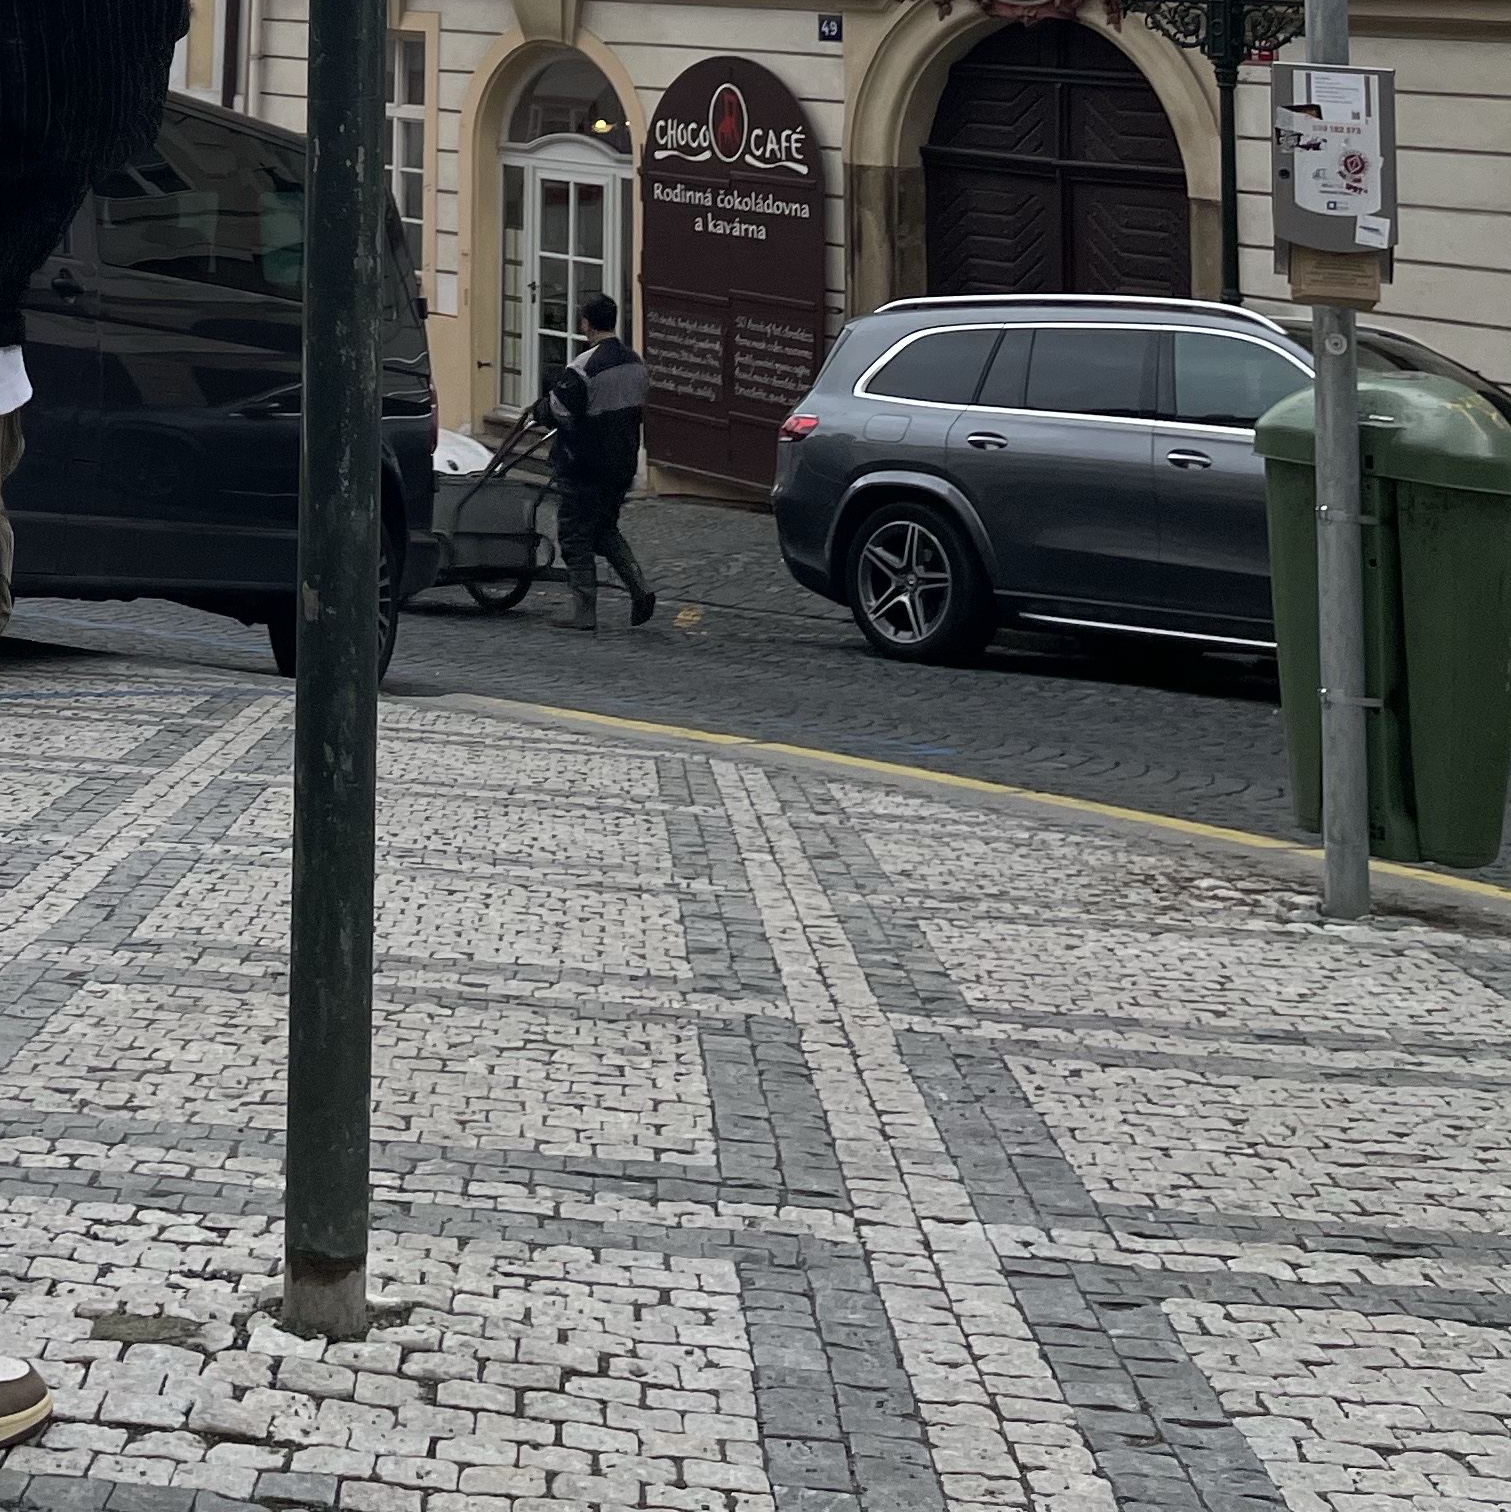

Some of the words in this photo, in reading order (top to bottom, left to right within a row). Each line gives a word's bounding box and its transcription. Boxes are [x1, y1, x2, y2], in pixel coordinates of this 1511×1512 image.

[821, 19, 838, 36] 49
[655, 118, 710, 149] CHOCO
[750, 125, 806, 160] CAFÉ
[653, 182, 712, 207] Rodinná
[716, 189, 810, 219] čokoládovna
[694, 216, 704, 232] a
[707, 212, 767, 240] kavárna
